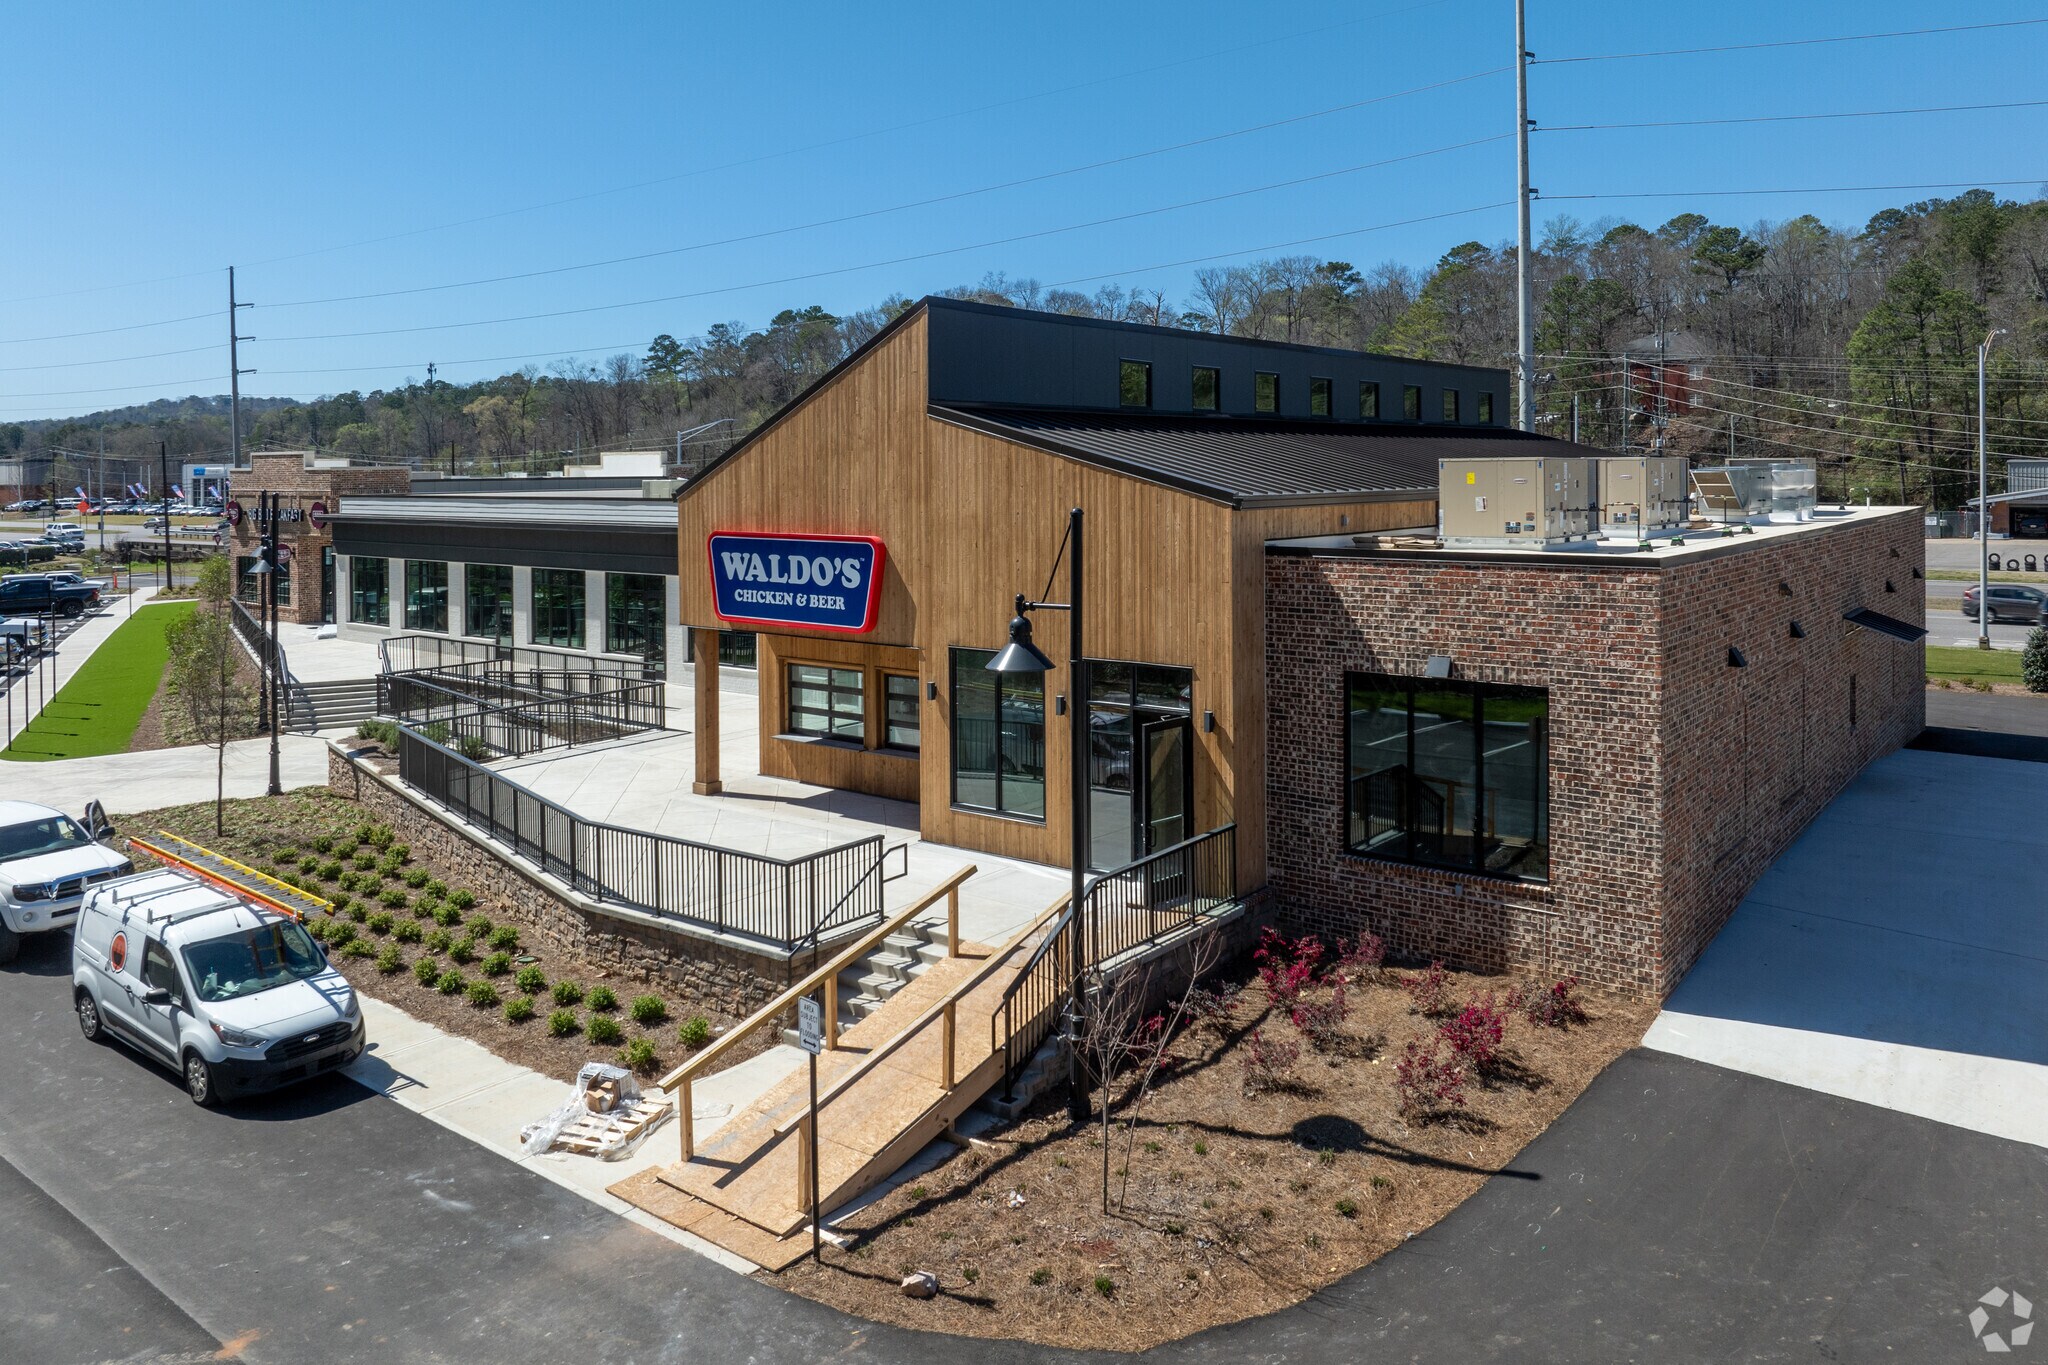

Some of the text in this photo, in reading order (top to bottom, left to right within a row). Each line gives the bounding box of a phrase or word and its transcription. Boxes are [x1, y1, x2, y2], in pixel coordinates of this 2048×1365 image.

[248, 508, 257, 520] BIG
[720, 552, 861, 589] WALDO'S
[734, 588, 846, 611] CHICKEN & BEER
[804, 1004, 814, 1012] AREA
[800, 1011, 818, 1023] SUBJECT
[806, 1022, 812, 1030] TO
[800, 1028, 819, 1041] FLOODING
